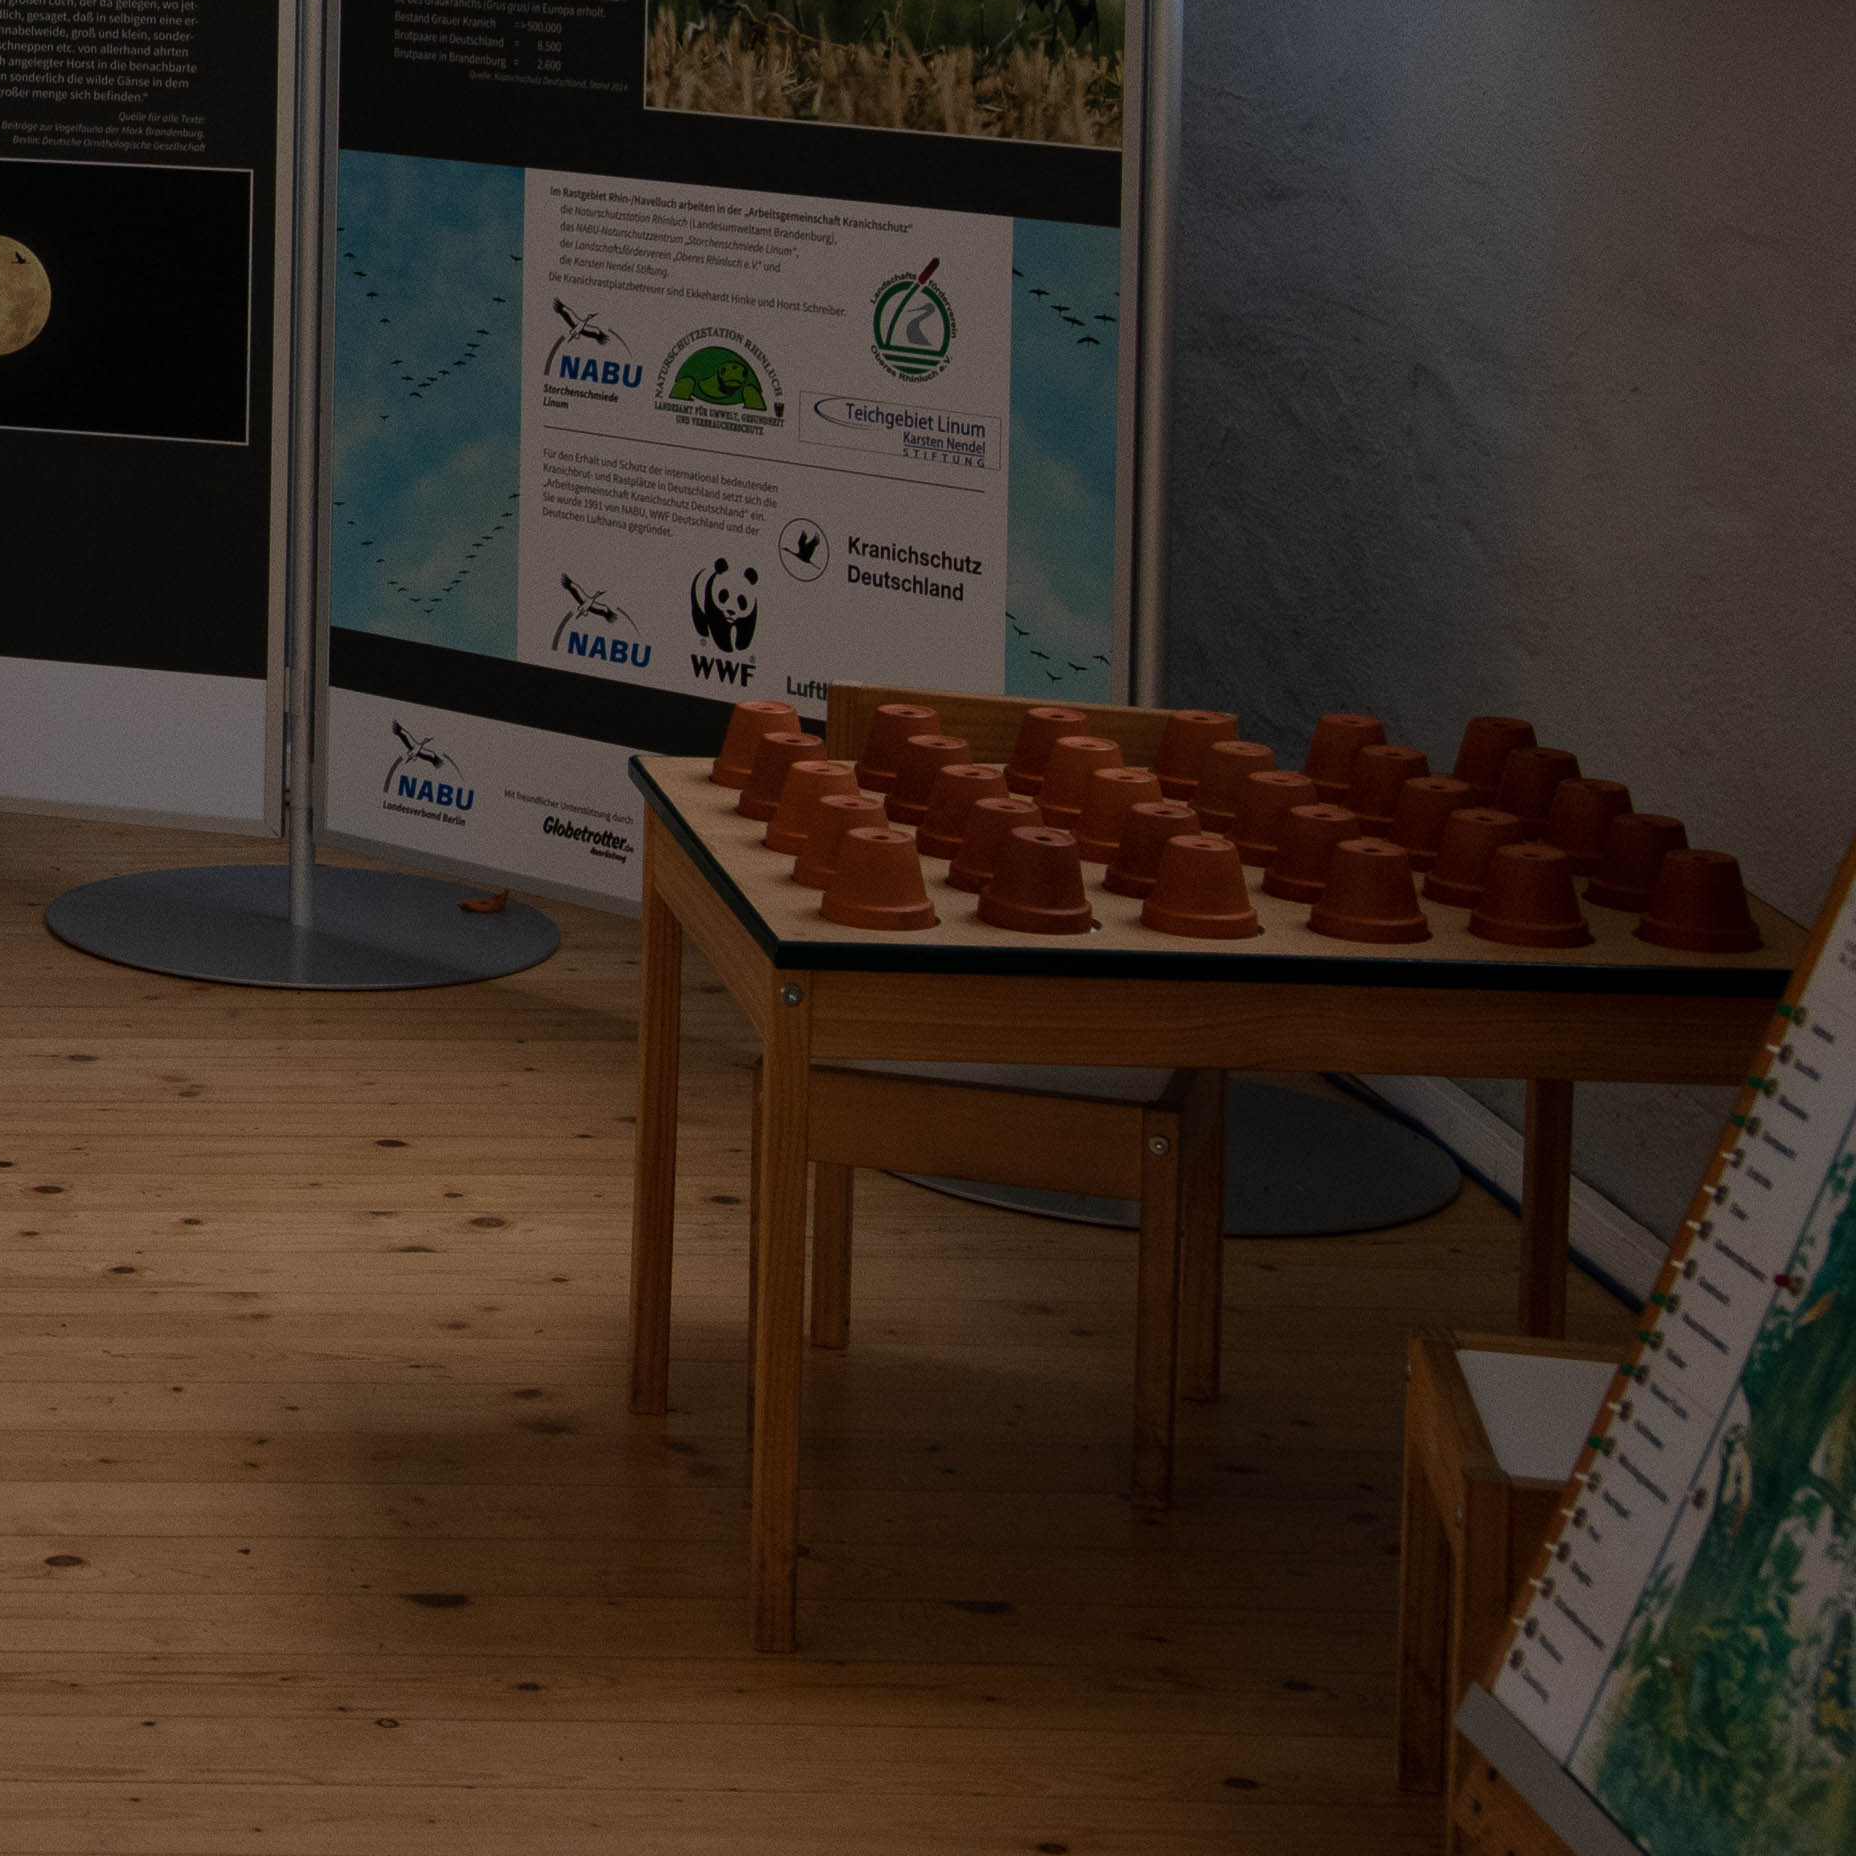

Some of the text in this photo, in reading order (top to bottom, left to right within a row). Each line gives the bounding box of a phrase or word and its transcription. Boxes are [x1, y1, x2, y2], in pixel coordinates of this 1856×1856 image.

[559, 355, 643, 388] NABU
[655, 326, 744, 399] NATURSCHUTZSTATION
[543, 383, 619, 403] Storchenschmiede
[543, 396, 569, 409] Linum
[845, 402, 985, 438] Teichgebiet Linum
[902, 431, 985, 454] Karsten Nendel
[848, 535, 983, 576] Kranichschutz
[847, 564, 964, 601] Deutschland
[567, 631, 652, 668] NABU
[690, 653, 757, 687] WWF
[398, 775, 475, 811] NABU
[382, 799, 466, 827] Landesverband Berlin
